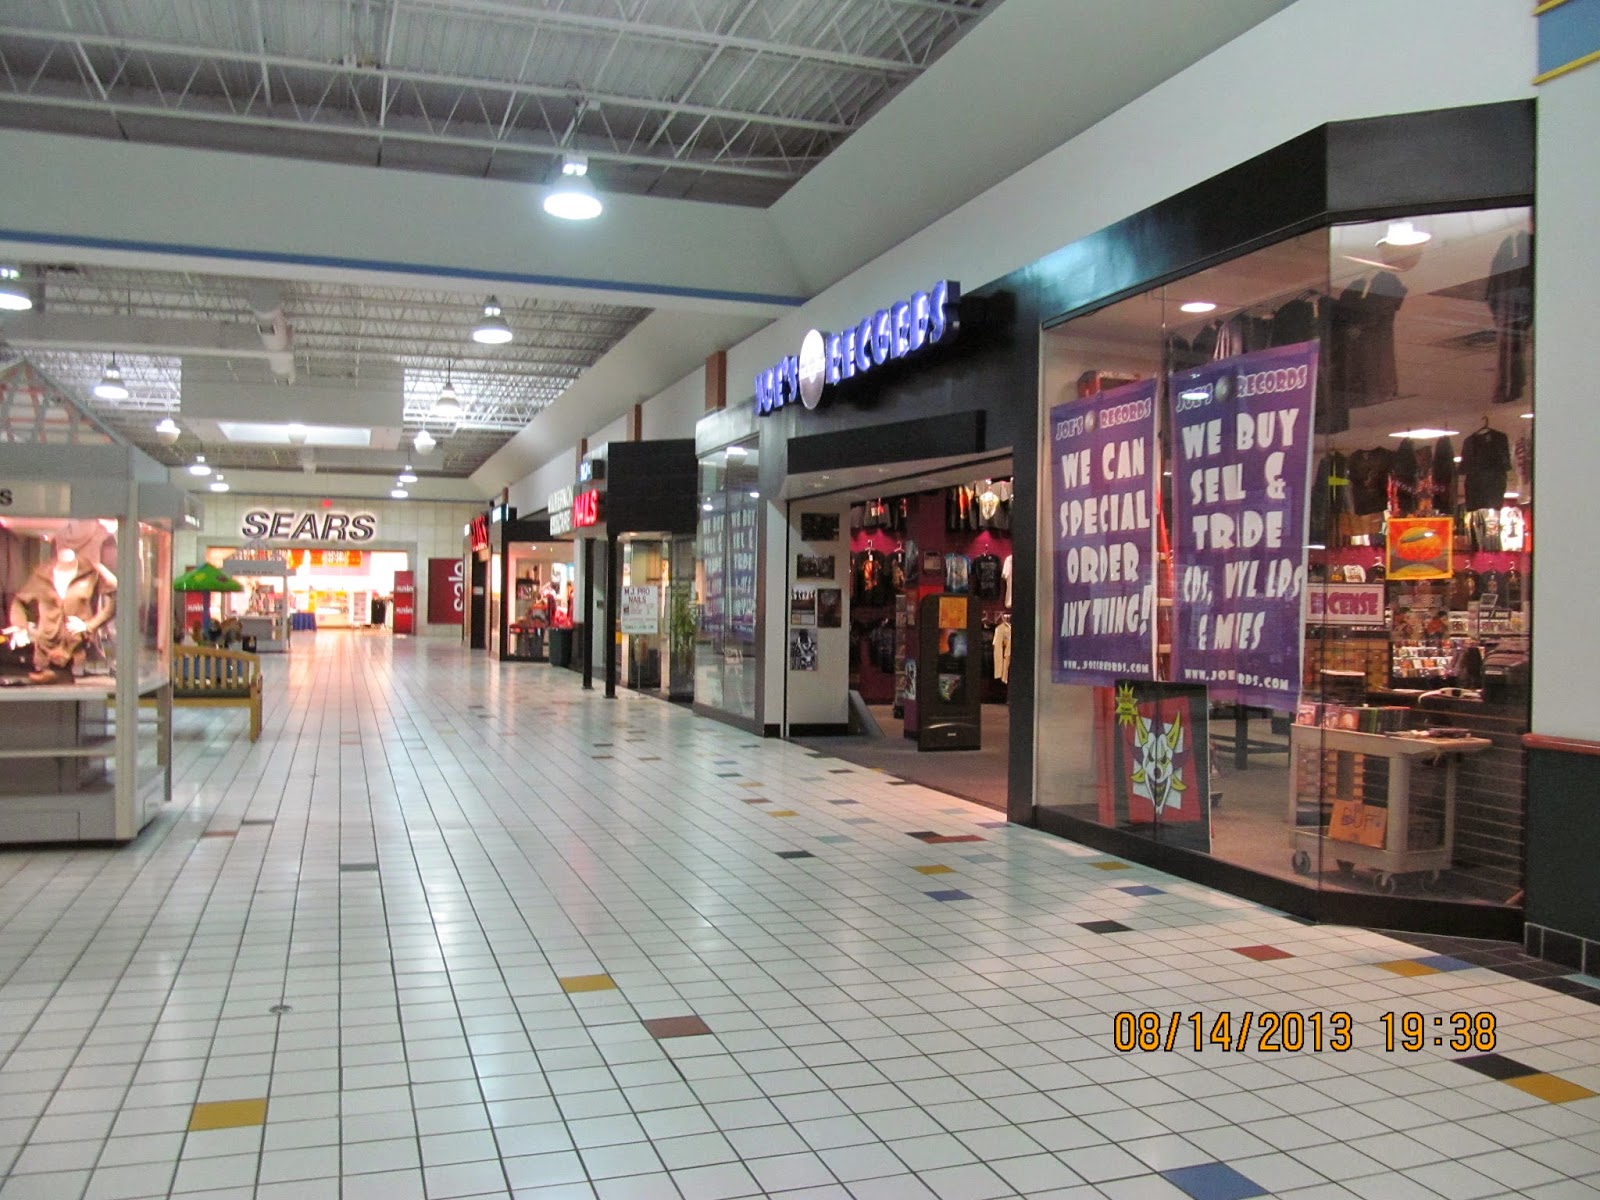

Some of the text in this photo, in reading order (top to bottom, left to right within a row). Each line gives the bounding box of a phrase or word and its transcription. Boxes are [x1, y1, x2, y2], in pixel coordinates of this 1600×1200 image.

[826, 279, 950, 386] RECORDS
[1237, 364, 1308, 398] RECORDS
[1100, 397, 1152, 429] RECORDS
[1182, 408, 1300, 460] WE BUY
[1062, 436, 1145, 490] WE CAN
[1264, 451, 1287, 499] &
[242, 510, 376, 541] SEARS
[1060, 489, 1150, 538] SPECIAL
[1192, 510, 1283, 550] TRDE
[1067, 541, 1140, 584] ORDER
[1266, 558, 1304, 598] LPS
